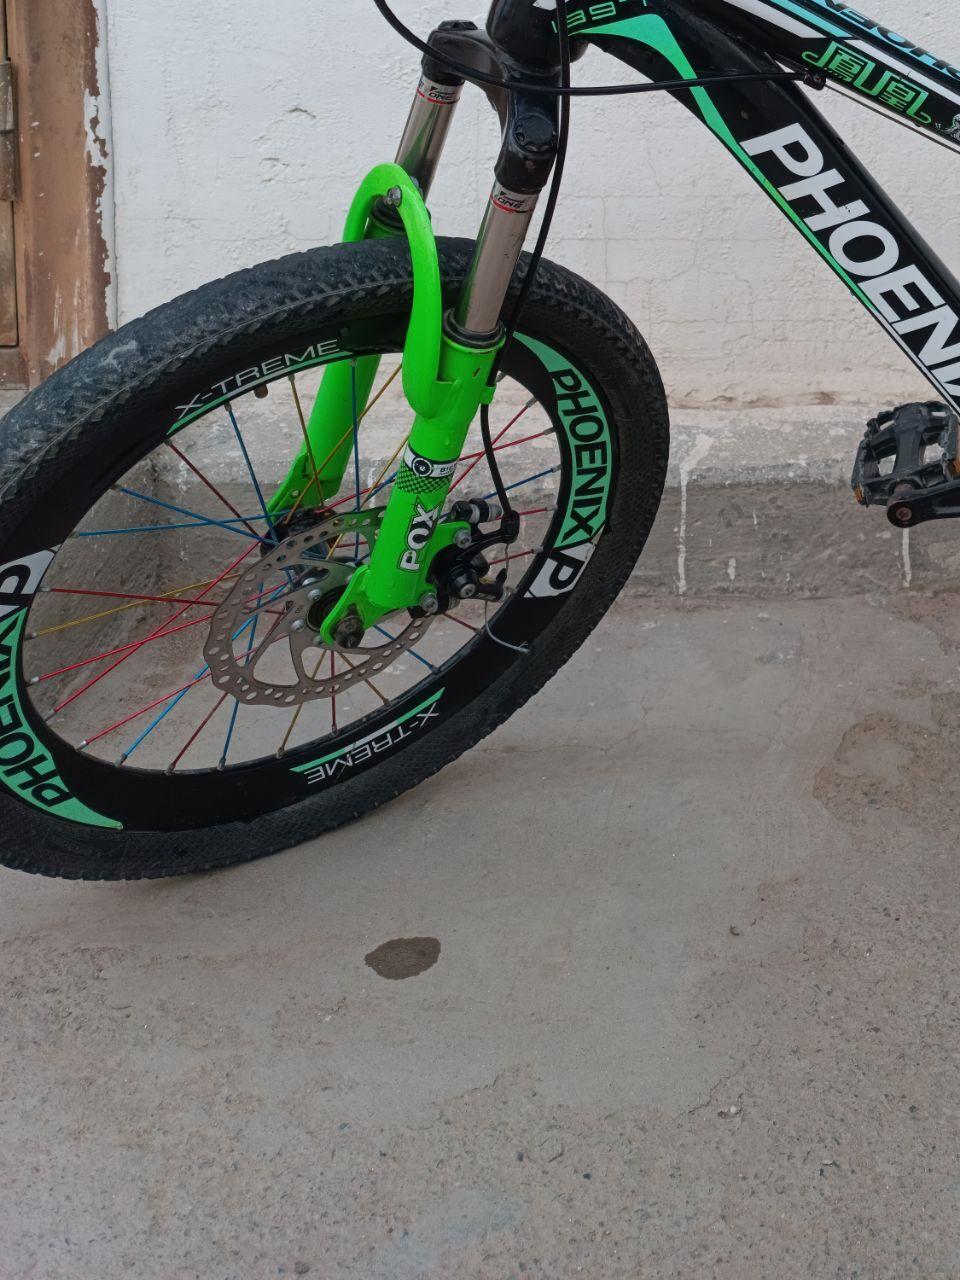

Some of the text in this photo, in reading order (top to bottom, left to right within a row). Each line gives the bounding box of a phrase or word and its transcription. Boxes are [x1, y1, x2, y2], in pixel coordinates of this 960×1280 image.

[174, 339, 340, 420] X-TREME
[552, 369, 608, 544] PHOENIX
[303, 702, 440, 784] X-TREME
